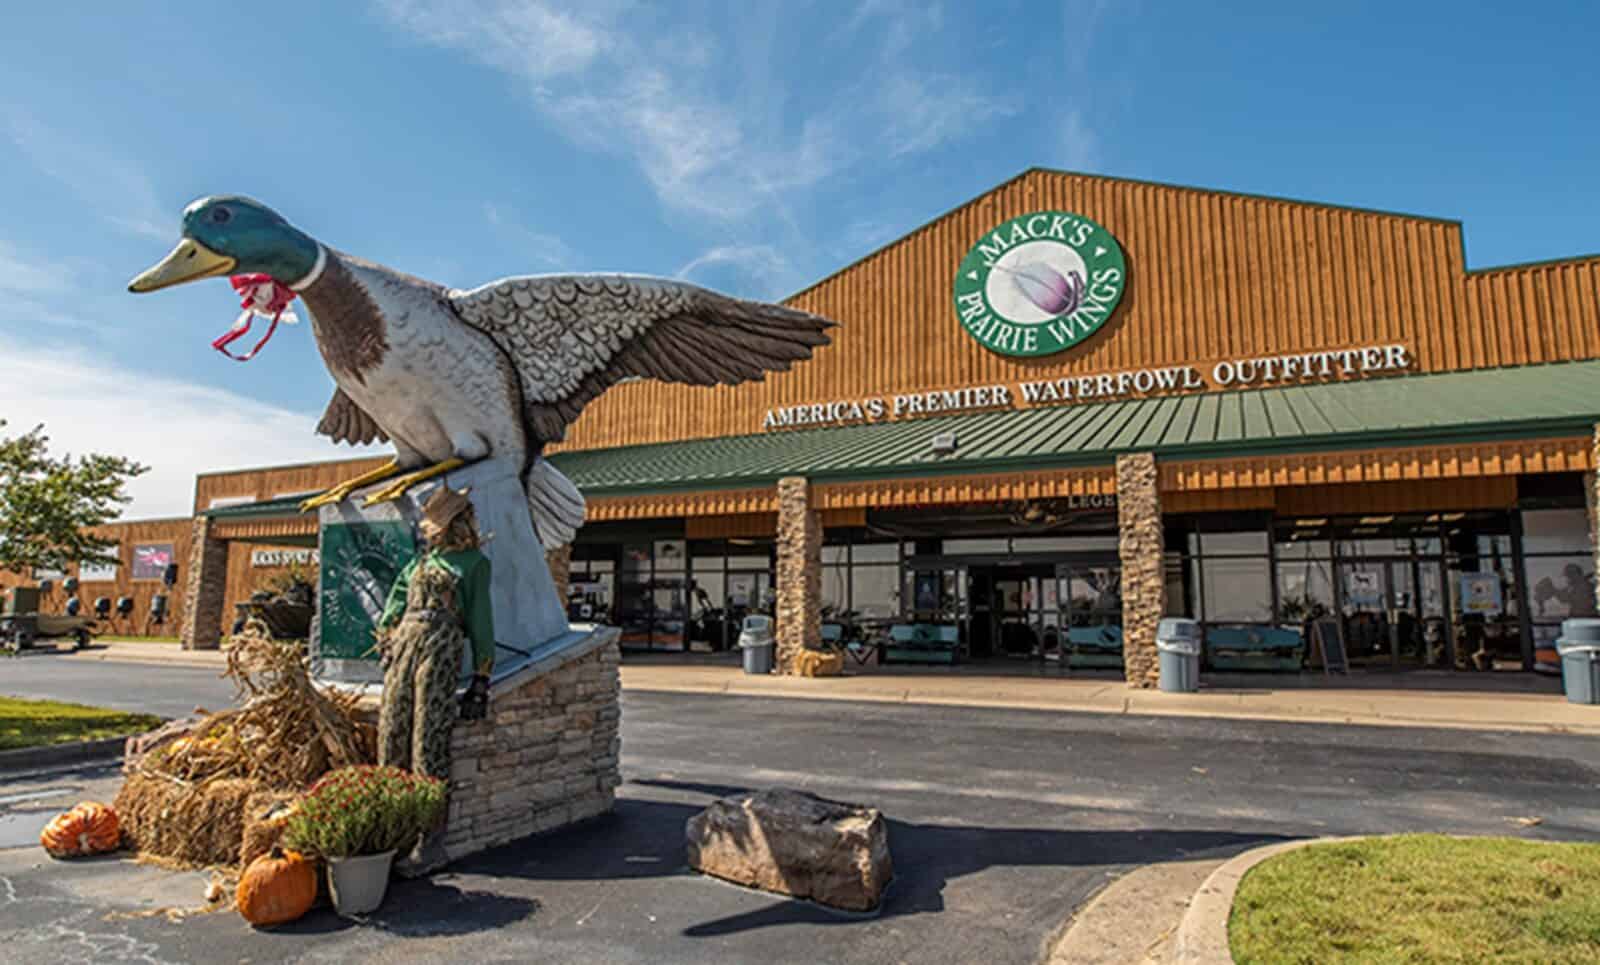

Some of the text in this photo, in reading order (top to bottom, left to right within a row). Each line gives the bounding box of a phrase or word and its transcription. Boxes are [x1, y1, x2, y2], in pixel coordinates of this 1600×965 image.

[978, 215, 1093, 268] MACK'S
[958, 267, 1121, 352] PRAIRIE WINGS
[763, 344, 1410, 428] AMERICA'S PREMIER WATERFOWL OUTFITTER
